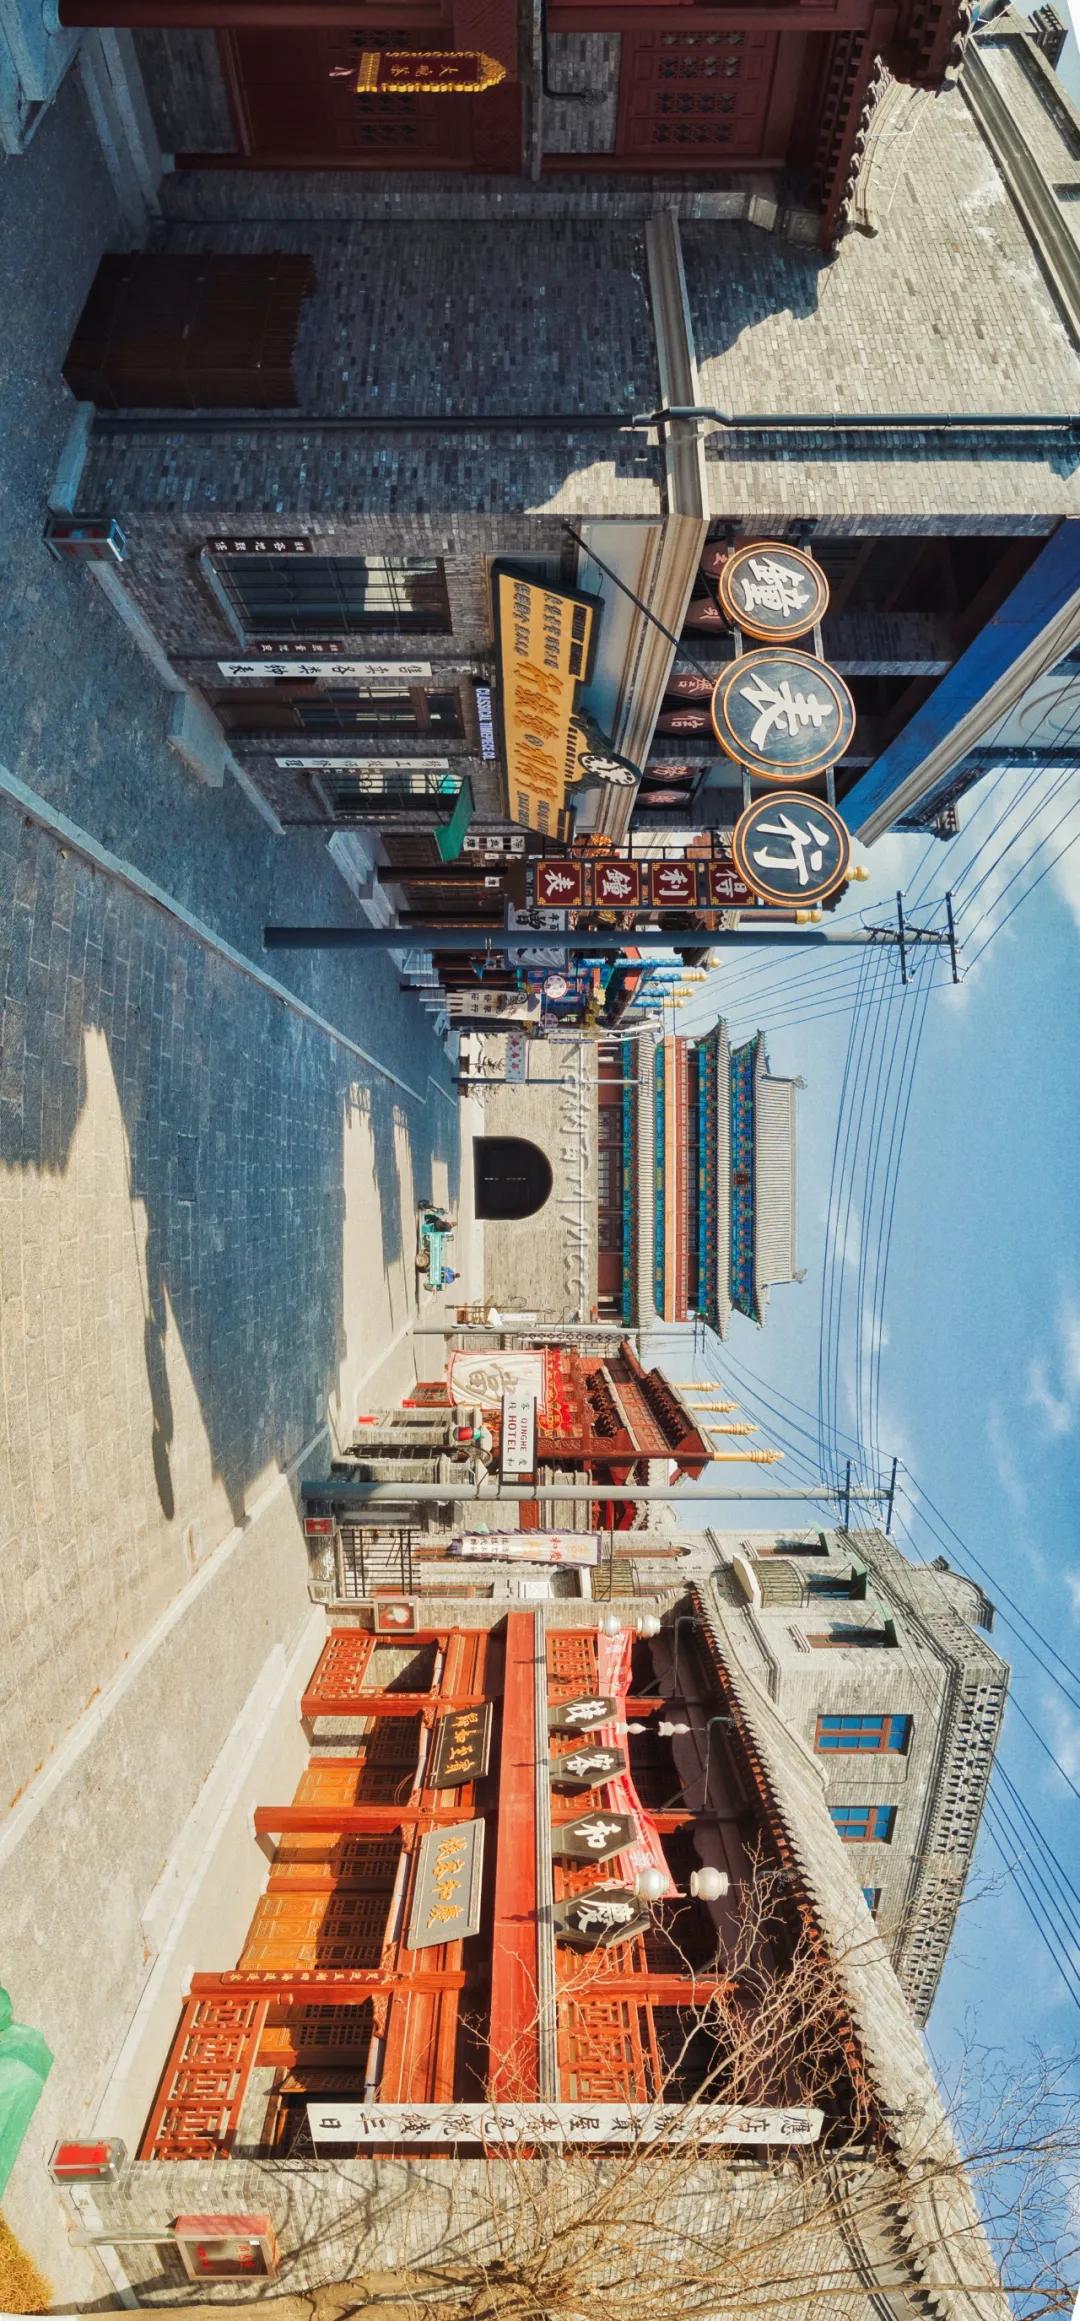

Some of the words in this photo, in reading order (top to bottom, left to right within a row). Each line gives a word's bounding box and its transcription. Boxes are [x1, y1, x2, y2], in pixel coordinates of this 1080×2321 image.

[476, 688, 492, 722] CLASSICAL
[739, 557, 834, 885] 鐘表行
[478, 722, 494, 751] TIMEPIECE
[544, 868, 747, 898] 得利鐘表
[507, 1415, 517, 1453] HOTEL
[520, 1418, 528, 1452] QINGHE
